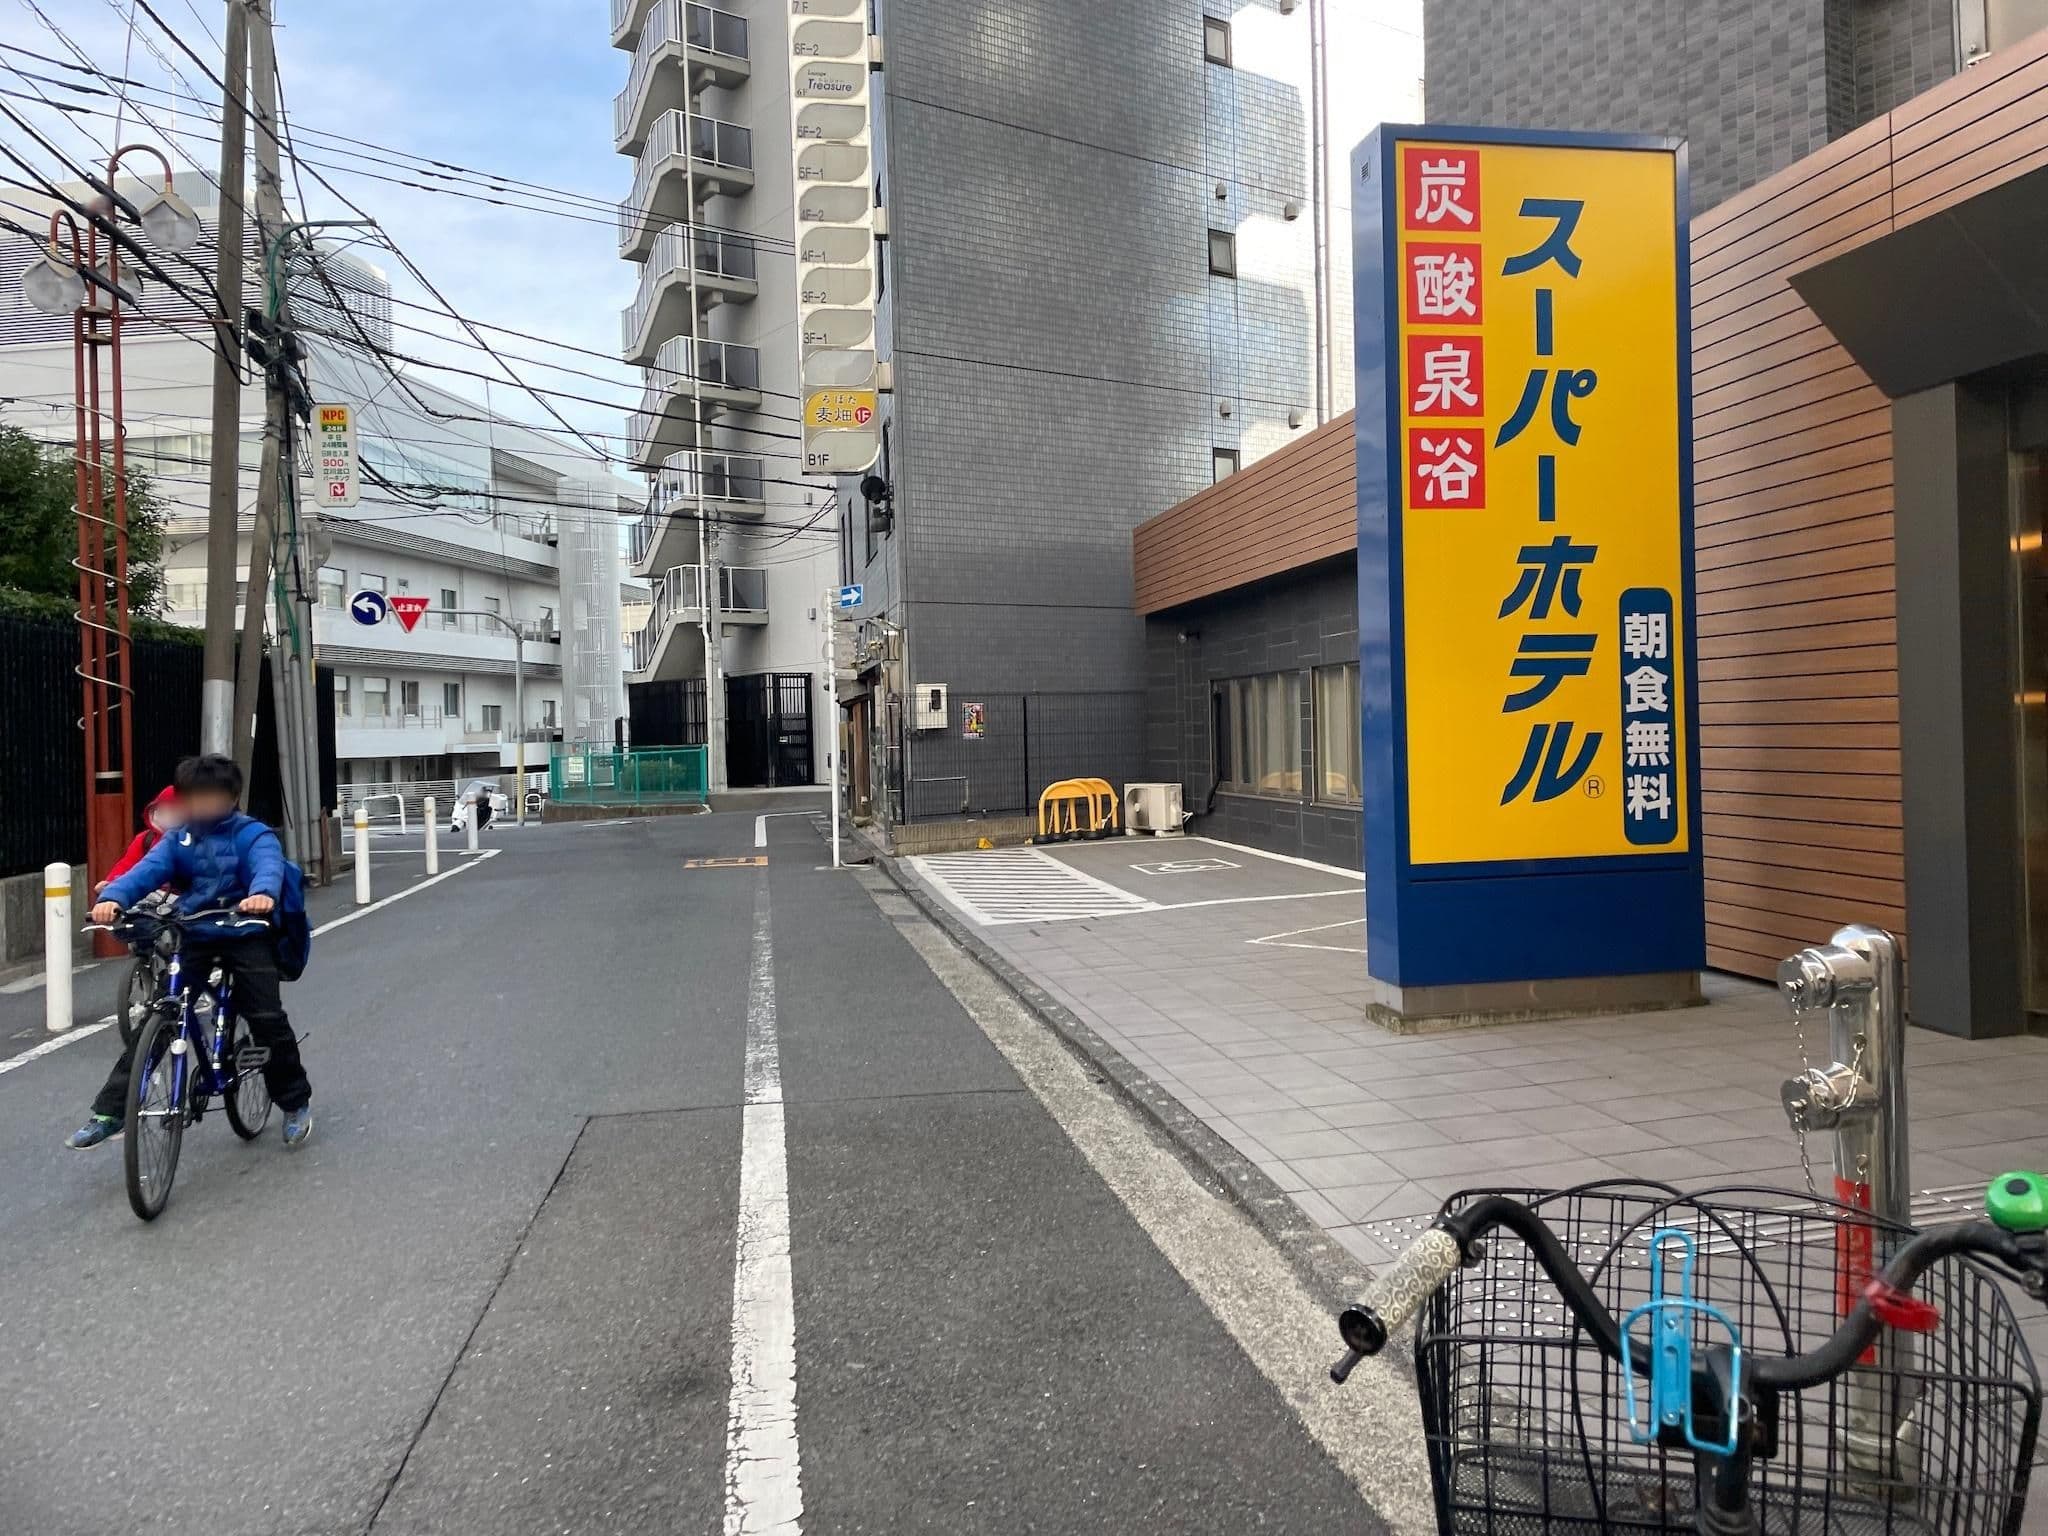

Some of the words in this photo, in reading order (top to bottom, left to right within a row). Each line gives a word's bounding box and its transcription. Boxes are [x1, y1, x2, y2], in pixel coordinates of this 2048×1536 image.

[793, 44, 819, 56] 6F-2
[807, 78, 853, 92] Treasure
[797, 126, 822, 139] 5F-2
[799, 168, 824, 180] 5F-1
[801, 251, 826, 262] 4F-1
[802, 291, 827, 303] 3F-2
[1414, 158, 1479, 501] 炭酸泉浴
[803, 333, 827, 344] 3F-1
[322, 410, 345, 421] NPC
[815, 407, 852, 423] 麦畑
[856, 409, 870, 422] 1F
[808, 453, 830, 466] B1F
[1494, 198, 1603, 806] スーパーホテル
[397, 602, 422, 612] 止まれ
[1623, 612, 1672, 821] 朝食無料
